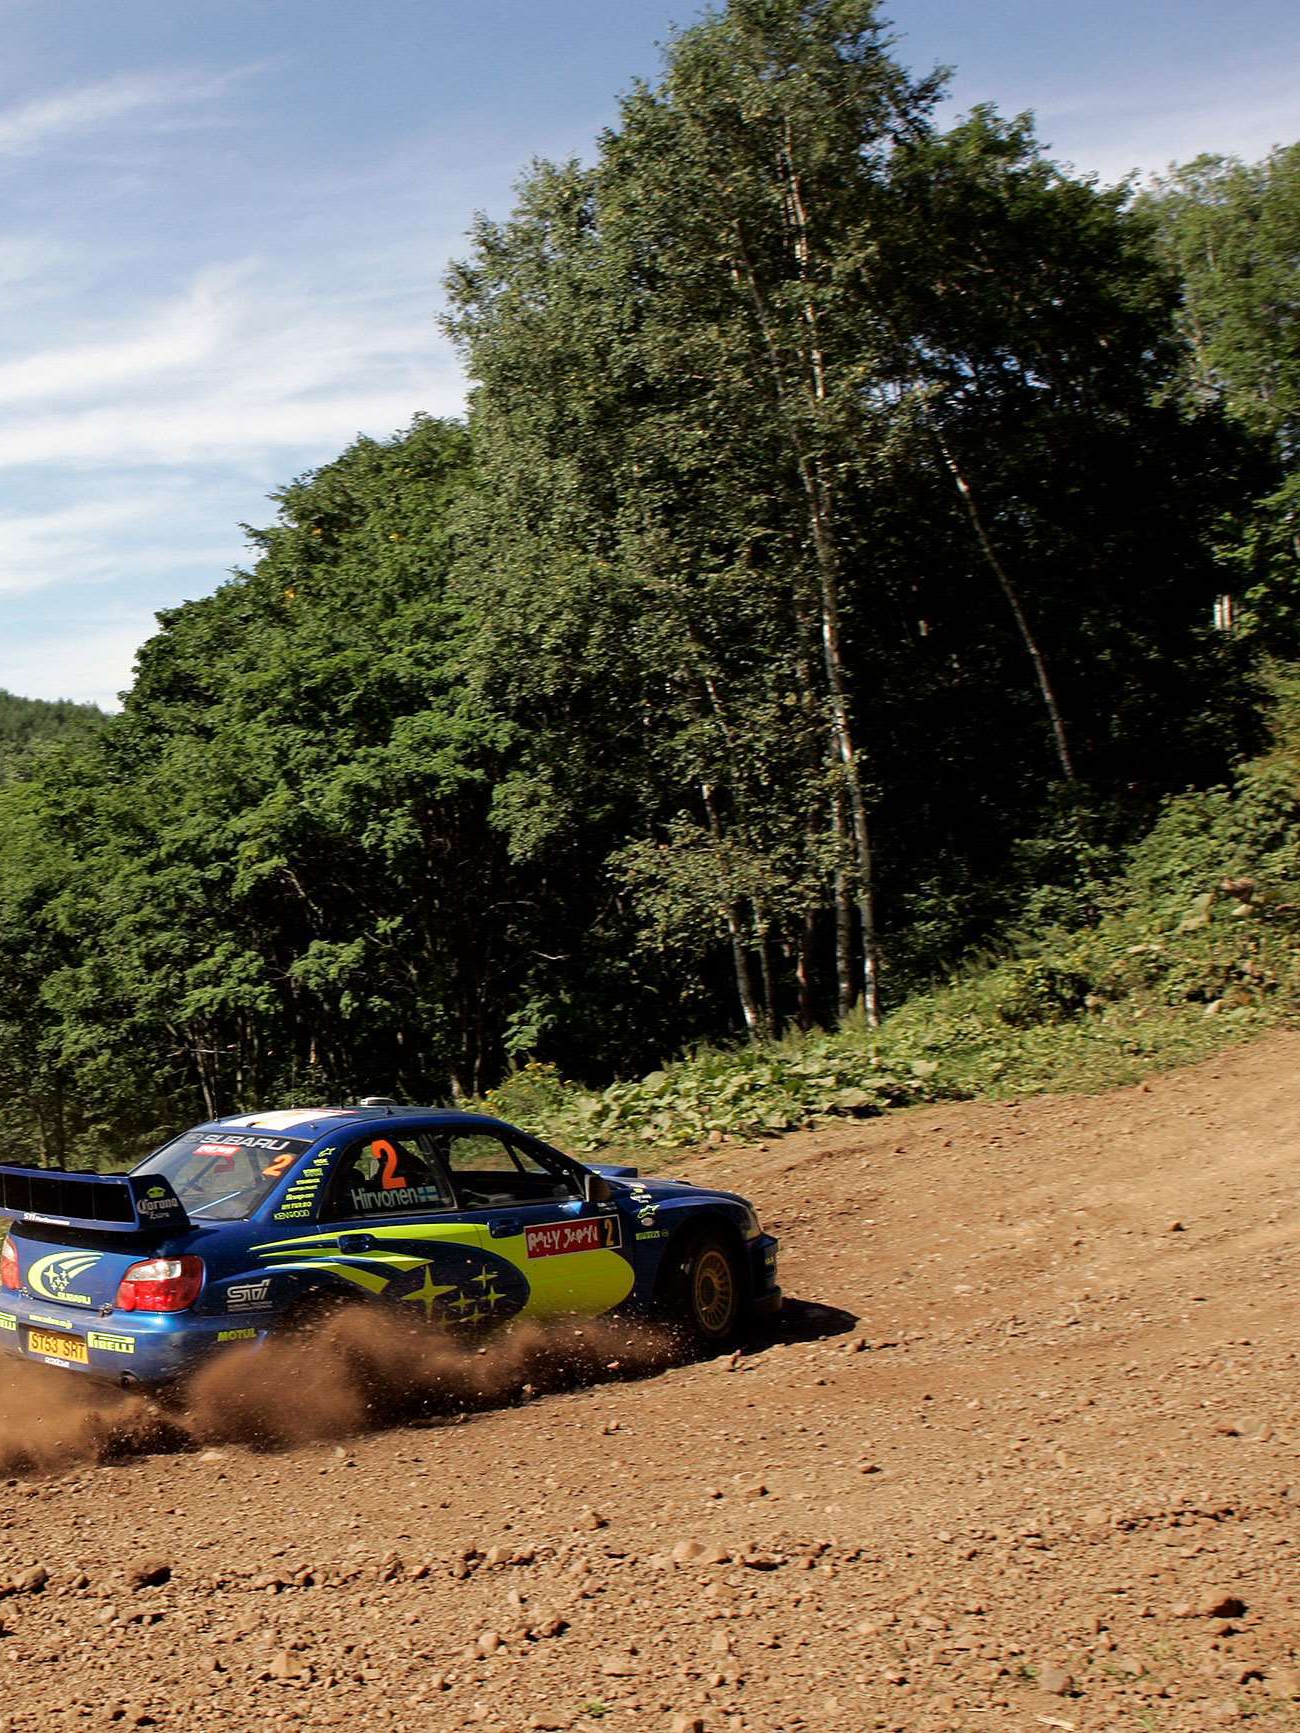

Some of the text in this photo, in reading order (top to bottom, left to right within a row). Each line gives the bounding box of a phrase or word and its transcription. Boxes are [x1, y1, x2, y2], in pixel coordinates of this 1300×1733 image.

[200, 1134, 290, 1151] SUBARU
[262, 1153, 294, 1177] 2
[371, 1140, 407, 1190] 2
[136, 1198, 179, 1215] Corona
[351, 1187, 419, 1210] Hirvonen
[274, 1209, 310, 1220] KENWOOD
[604, 1219, 615, 1246] 2
[56, 1291, 92, 1304] SUBARU
[88, 1331, 135, 1353] PIRELLI
[217, 1328, 257, 1341] MOTUL
[31, 1333, 85, 1359] ST53 SRT
